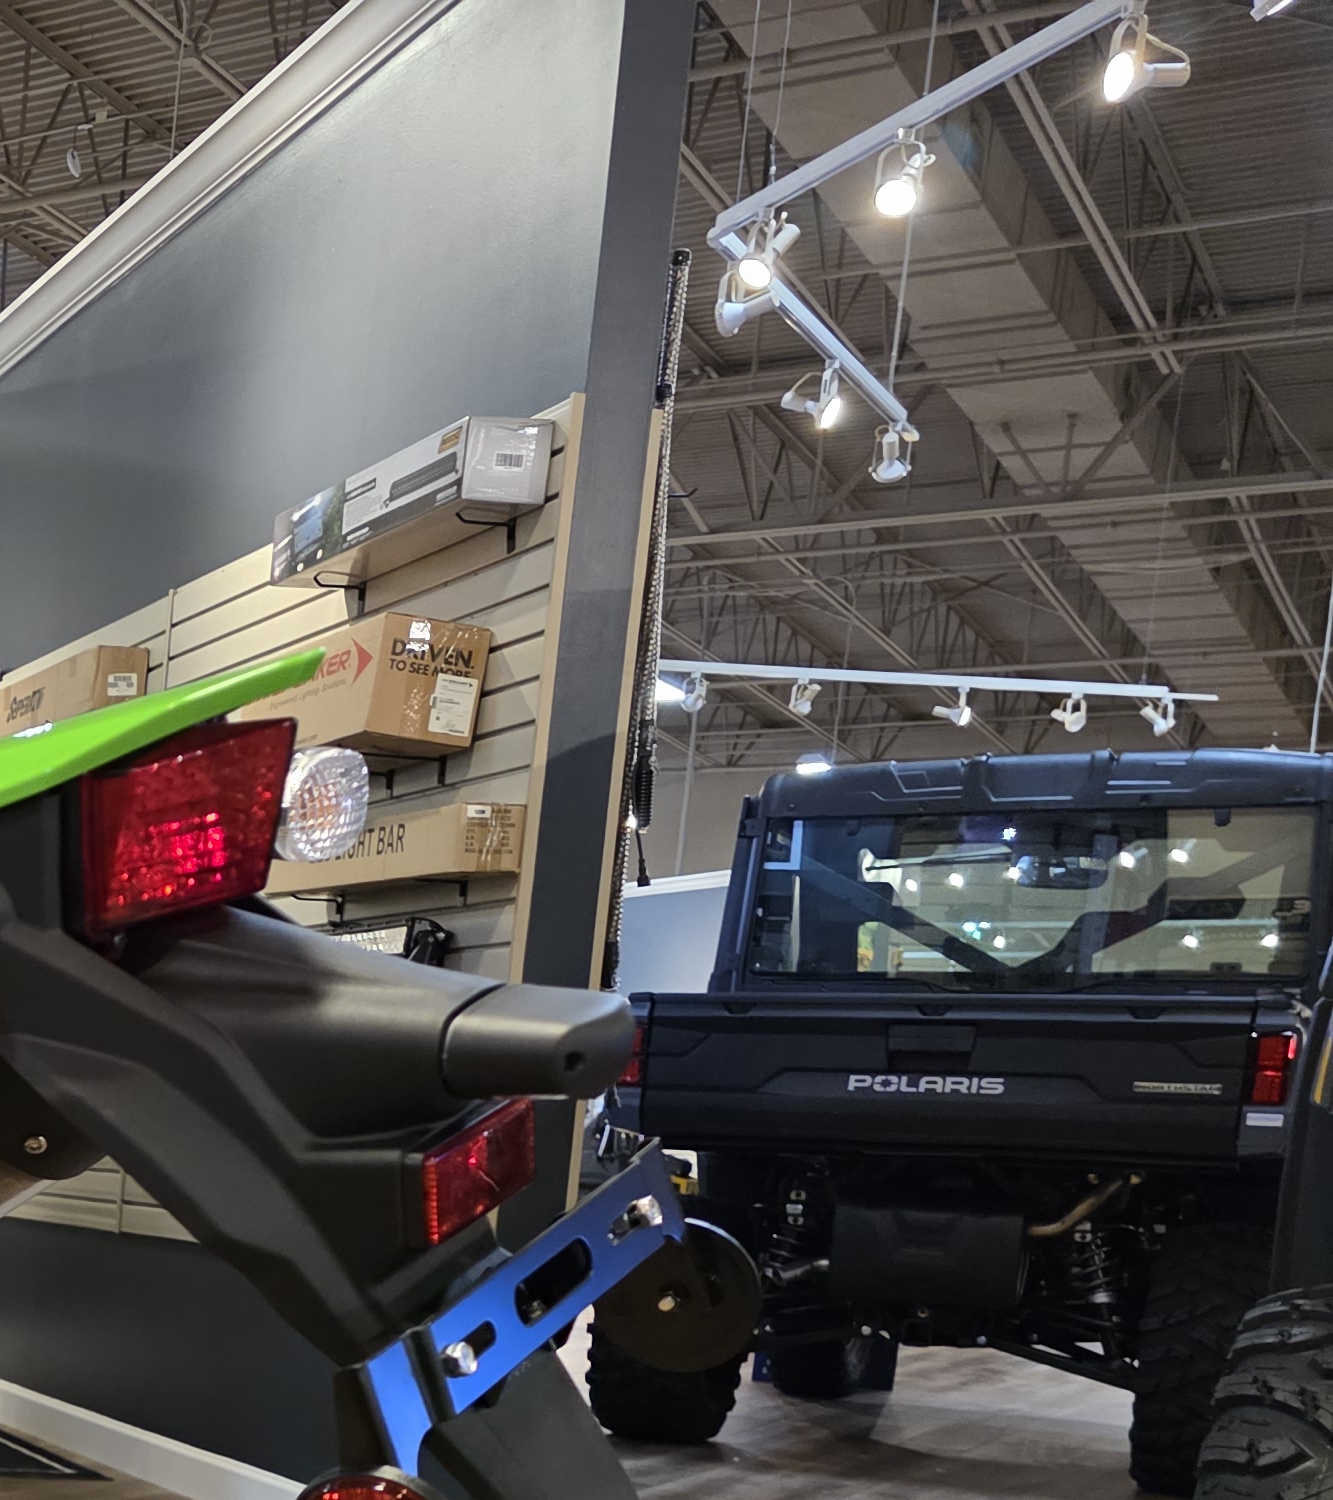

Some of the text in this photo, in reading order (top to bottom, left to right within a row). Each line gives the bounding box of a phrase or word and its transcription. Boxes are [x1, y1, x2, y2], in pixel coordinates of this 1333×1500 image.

[389, 658, 407, 671] TO
[408, 661, 430, 676] SEE
[376, 823, 406, 855] BAR
[846, 1074, 1005, 1096] POLARIS
